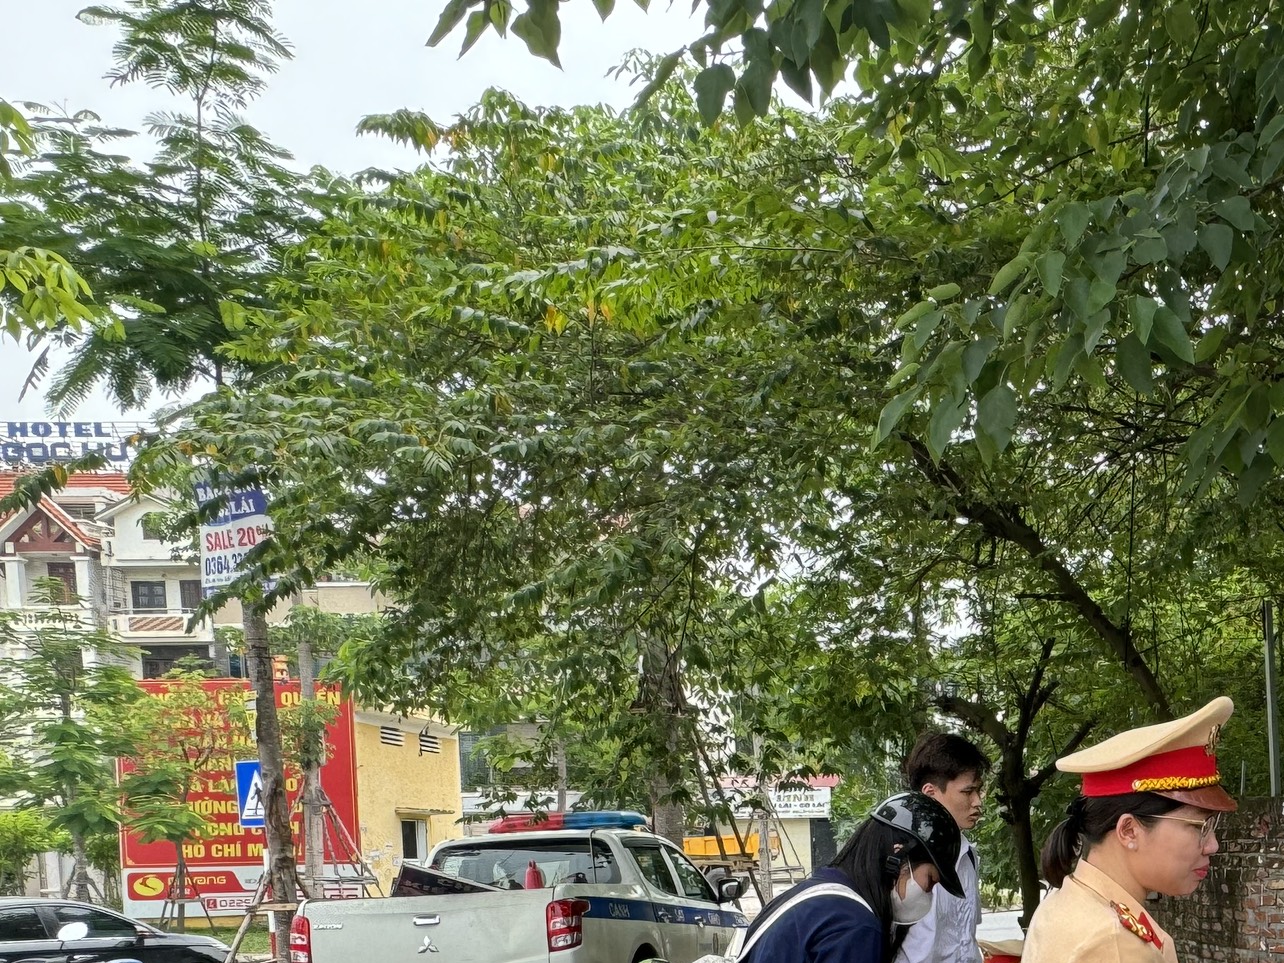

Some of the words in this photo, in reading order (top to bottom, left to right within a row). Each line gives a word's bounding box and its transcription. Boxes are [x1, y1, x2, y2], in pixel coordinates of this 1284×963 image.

[7, 421, 112, 438] HOTEL
[205, 529, 235, 552] SALE
[211, 839, 242, 858] CHÍ
